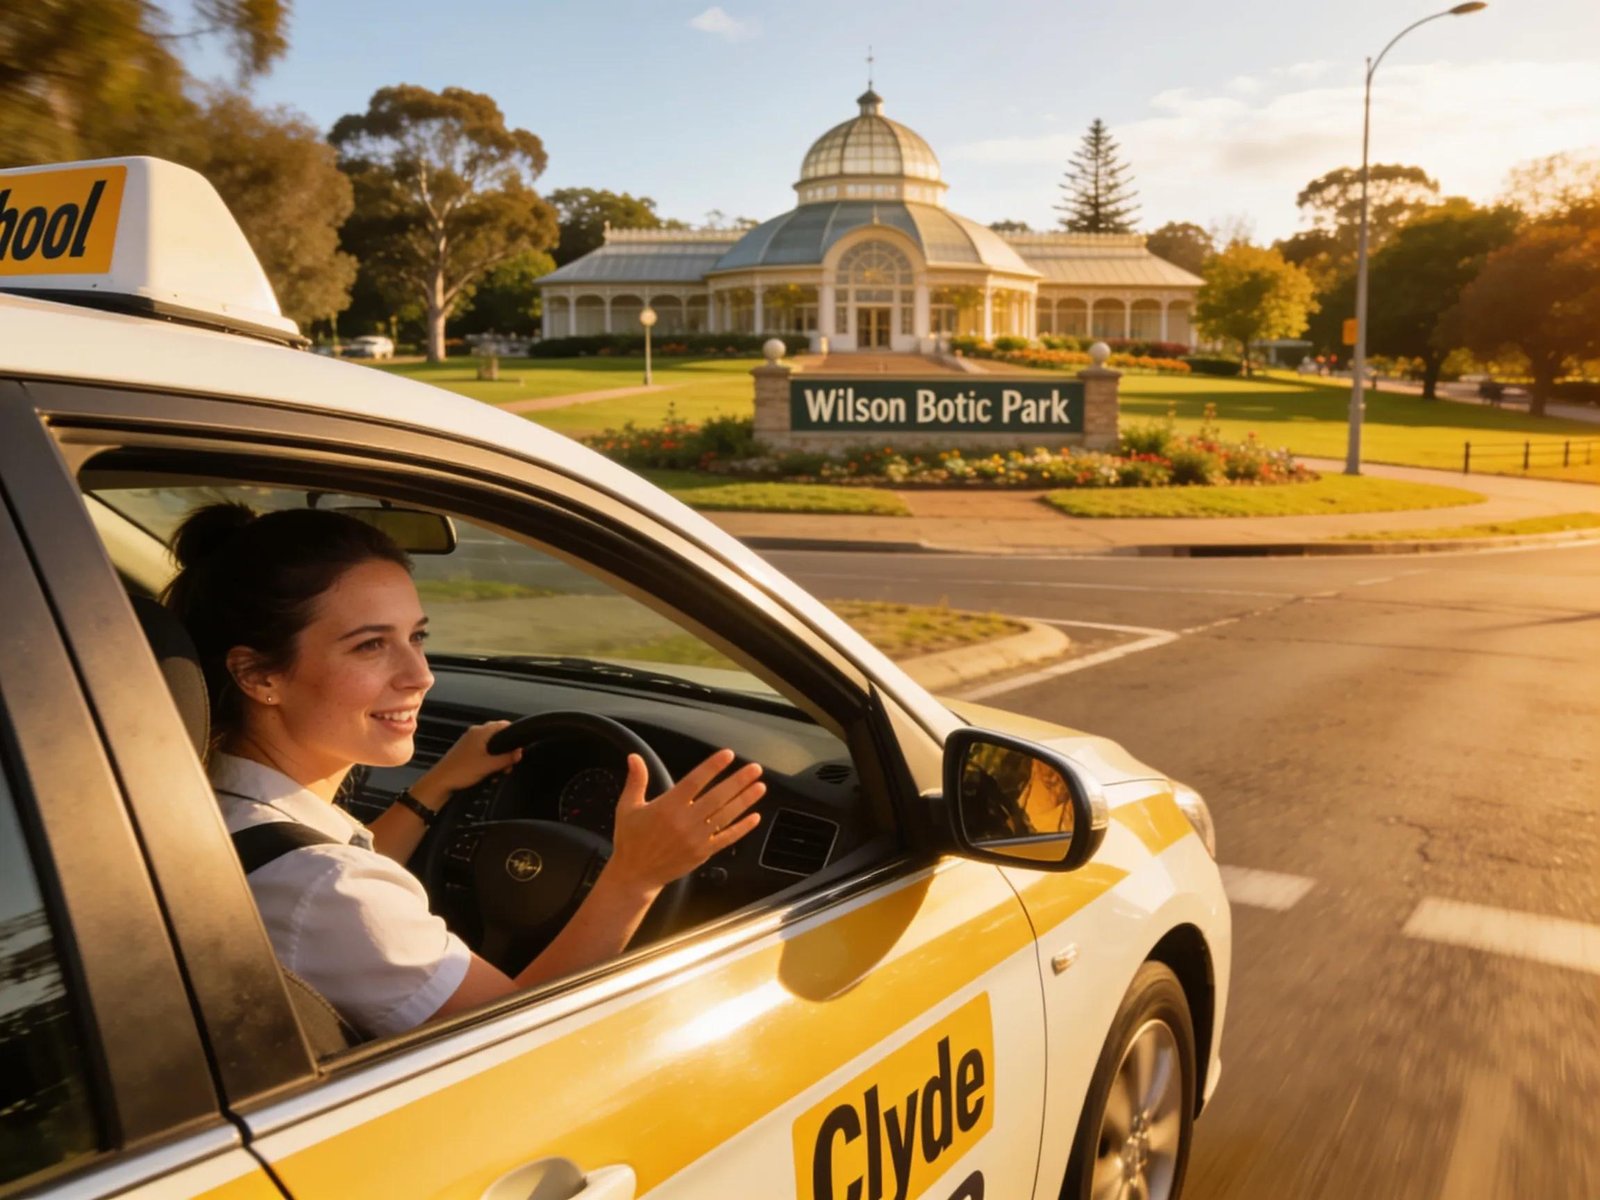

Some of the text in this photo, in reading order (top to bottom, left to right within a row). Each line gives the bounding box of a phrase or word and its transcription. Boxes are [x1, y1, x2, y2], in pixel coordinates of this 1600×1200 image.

[804, 388, 1071, 424] Wilson Botic Park
[812, 1035, 985, 1200] Clyde
